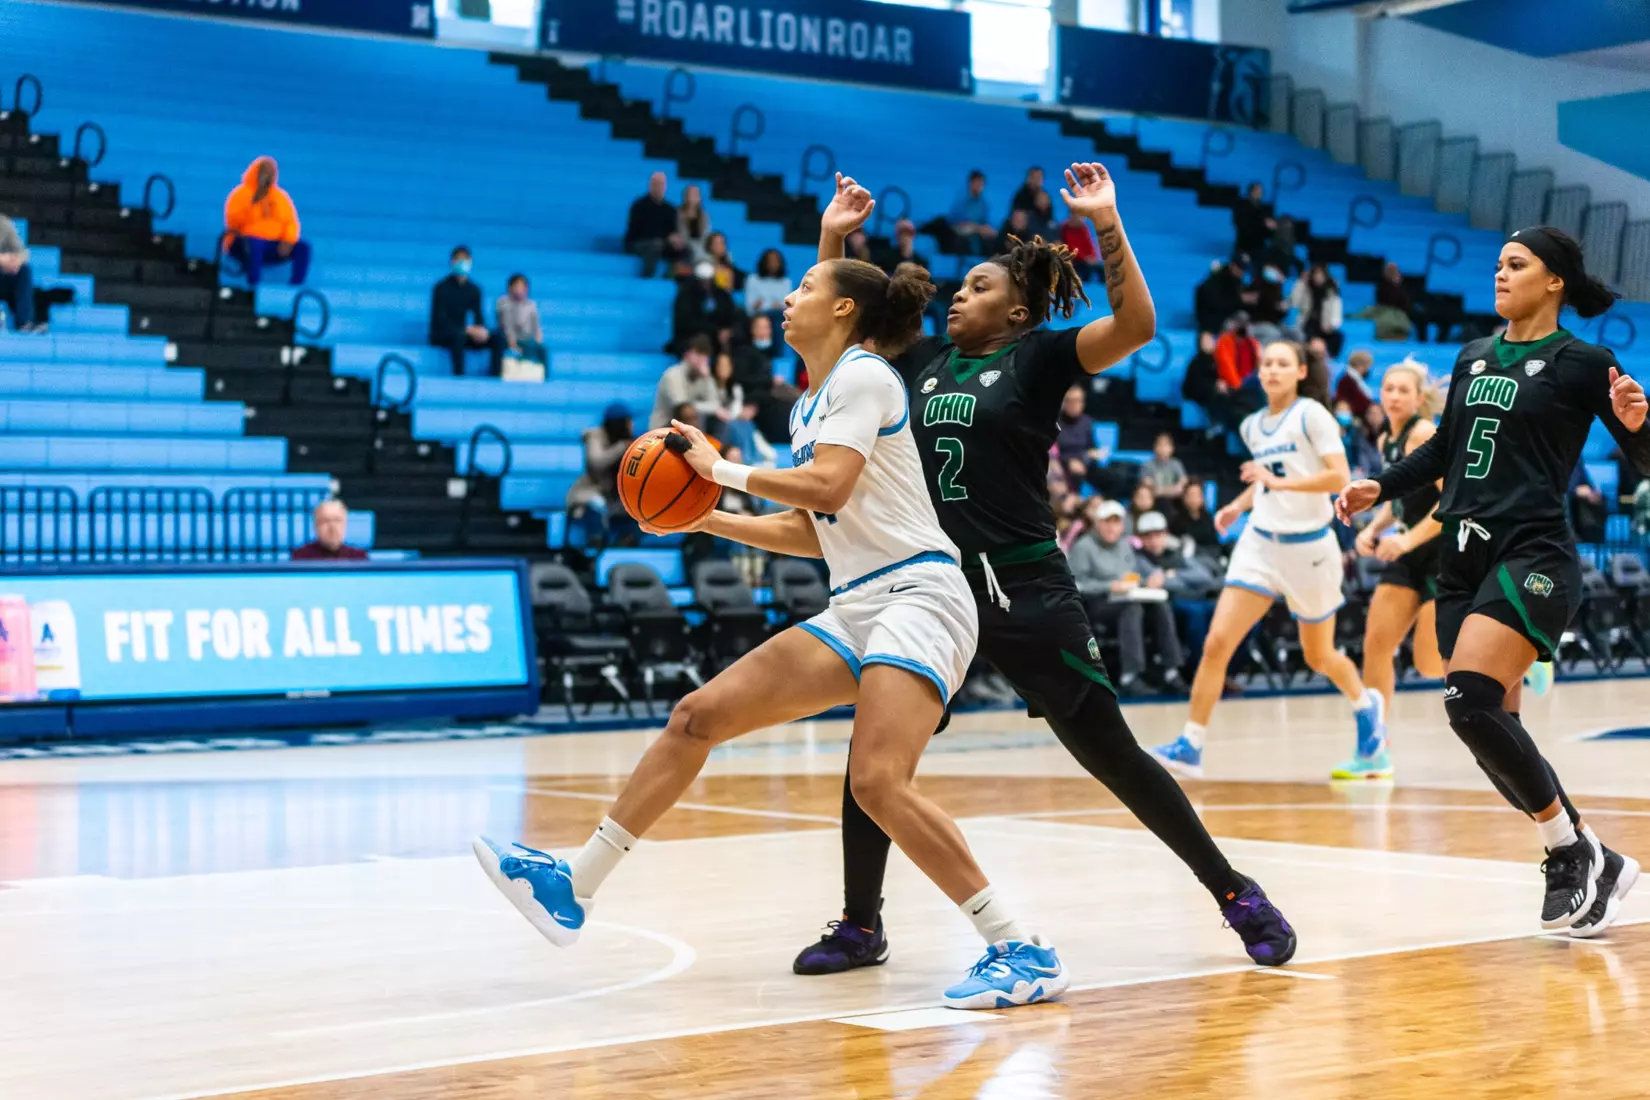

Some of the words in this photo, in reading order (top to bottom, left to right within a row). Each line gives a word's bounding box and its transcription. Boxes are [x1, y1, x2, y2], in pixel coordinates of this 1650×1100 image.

[923, 392, 977, 428] OHIO
[1466, 376, 1519, 411] OHIO
[935, 437, 968, 502] 2
[1464, 416, 1501, 480] 5
[104, 610, 173, 662] FIT
[185, 609, 272, 661] FOR
[283, 607, 362, 658] ALL
[368, 604, 492, 655] TIMES
